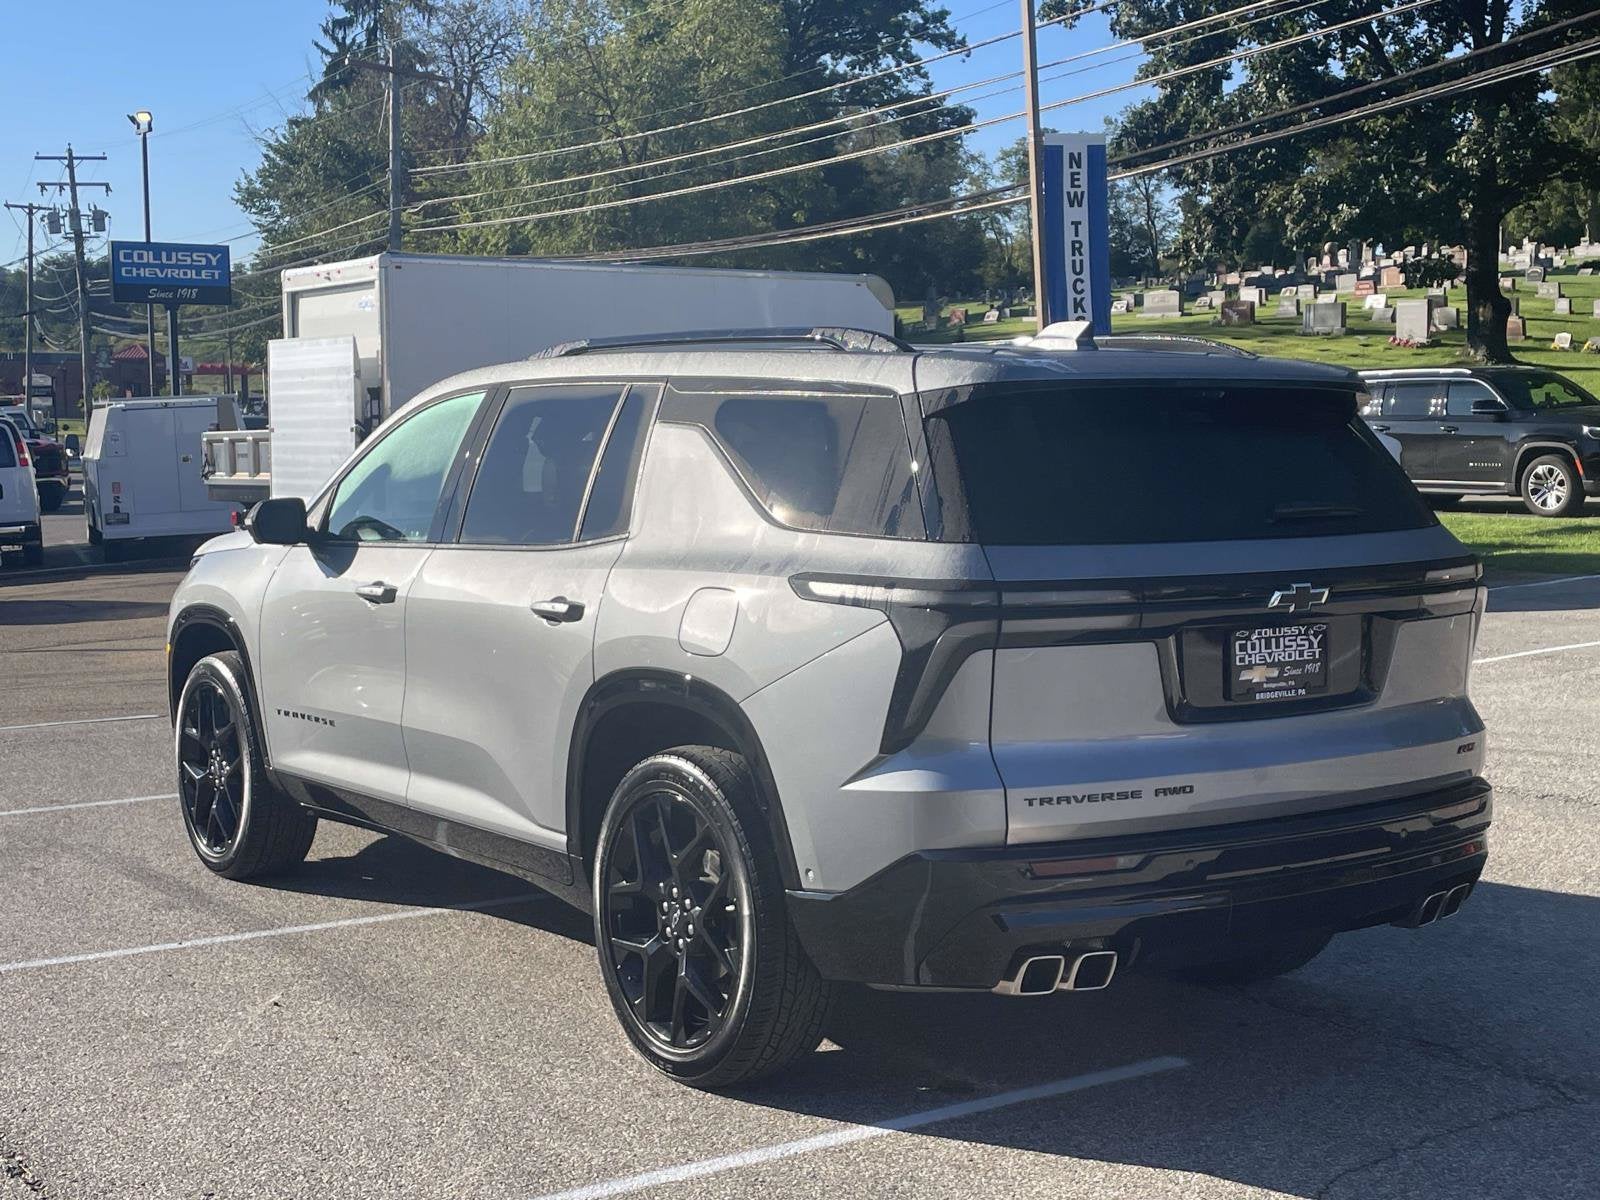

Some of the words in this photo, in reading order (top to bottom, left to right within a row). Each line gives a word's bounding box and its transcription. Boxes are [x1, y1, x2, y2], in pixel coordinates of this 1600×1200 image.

[1066, 151, 1085, 208] NEW
[119, 249, 222, 266] COLUSSY
[121, 267, 222, 280] CHEVROLET
[1070, 220, 1087, 321] TRUCK
[148, 288, 173, 299] Since
[176, 288, 199, 299] 1918
[1254, 625, 1308, 639] COLUSSY
[1235, 634, 1323, 655] COLUSSY
[1235, 648, 1322, 666] CHEVROLET
[1283, 665, 1302, 677] Since
[1304, 662, 1321, 674] 1918
[1298, 688, 1306, 696] PA
[1024, 790, 1143, 807] TRAVERSE
[1154, 784, 1194, 797] AWD
